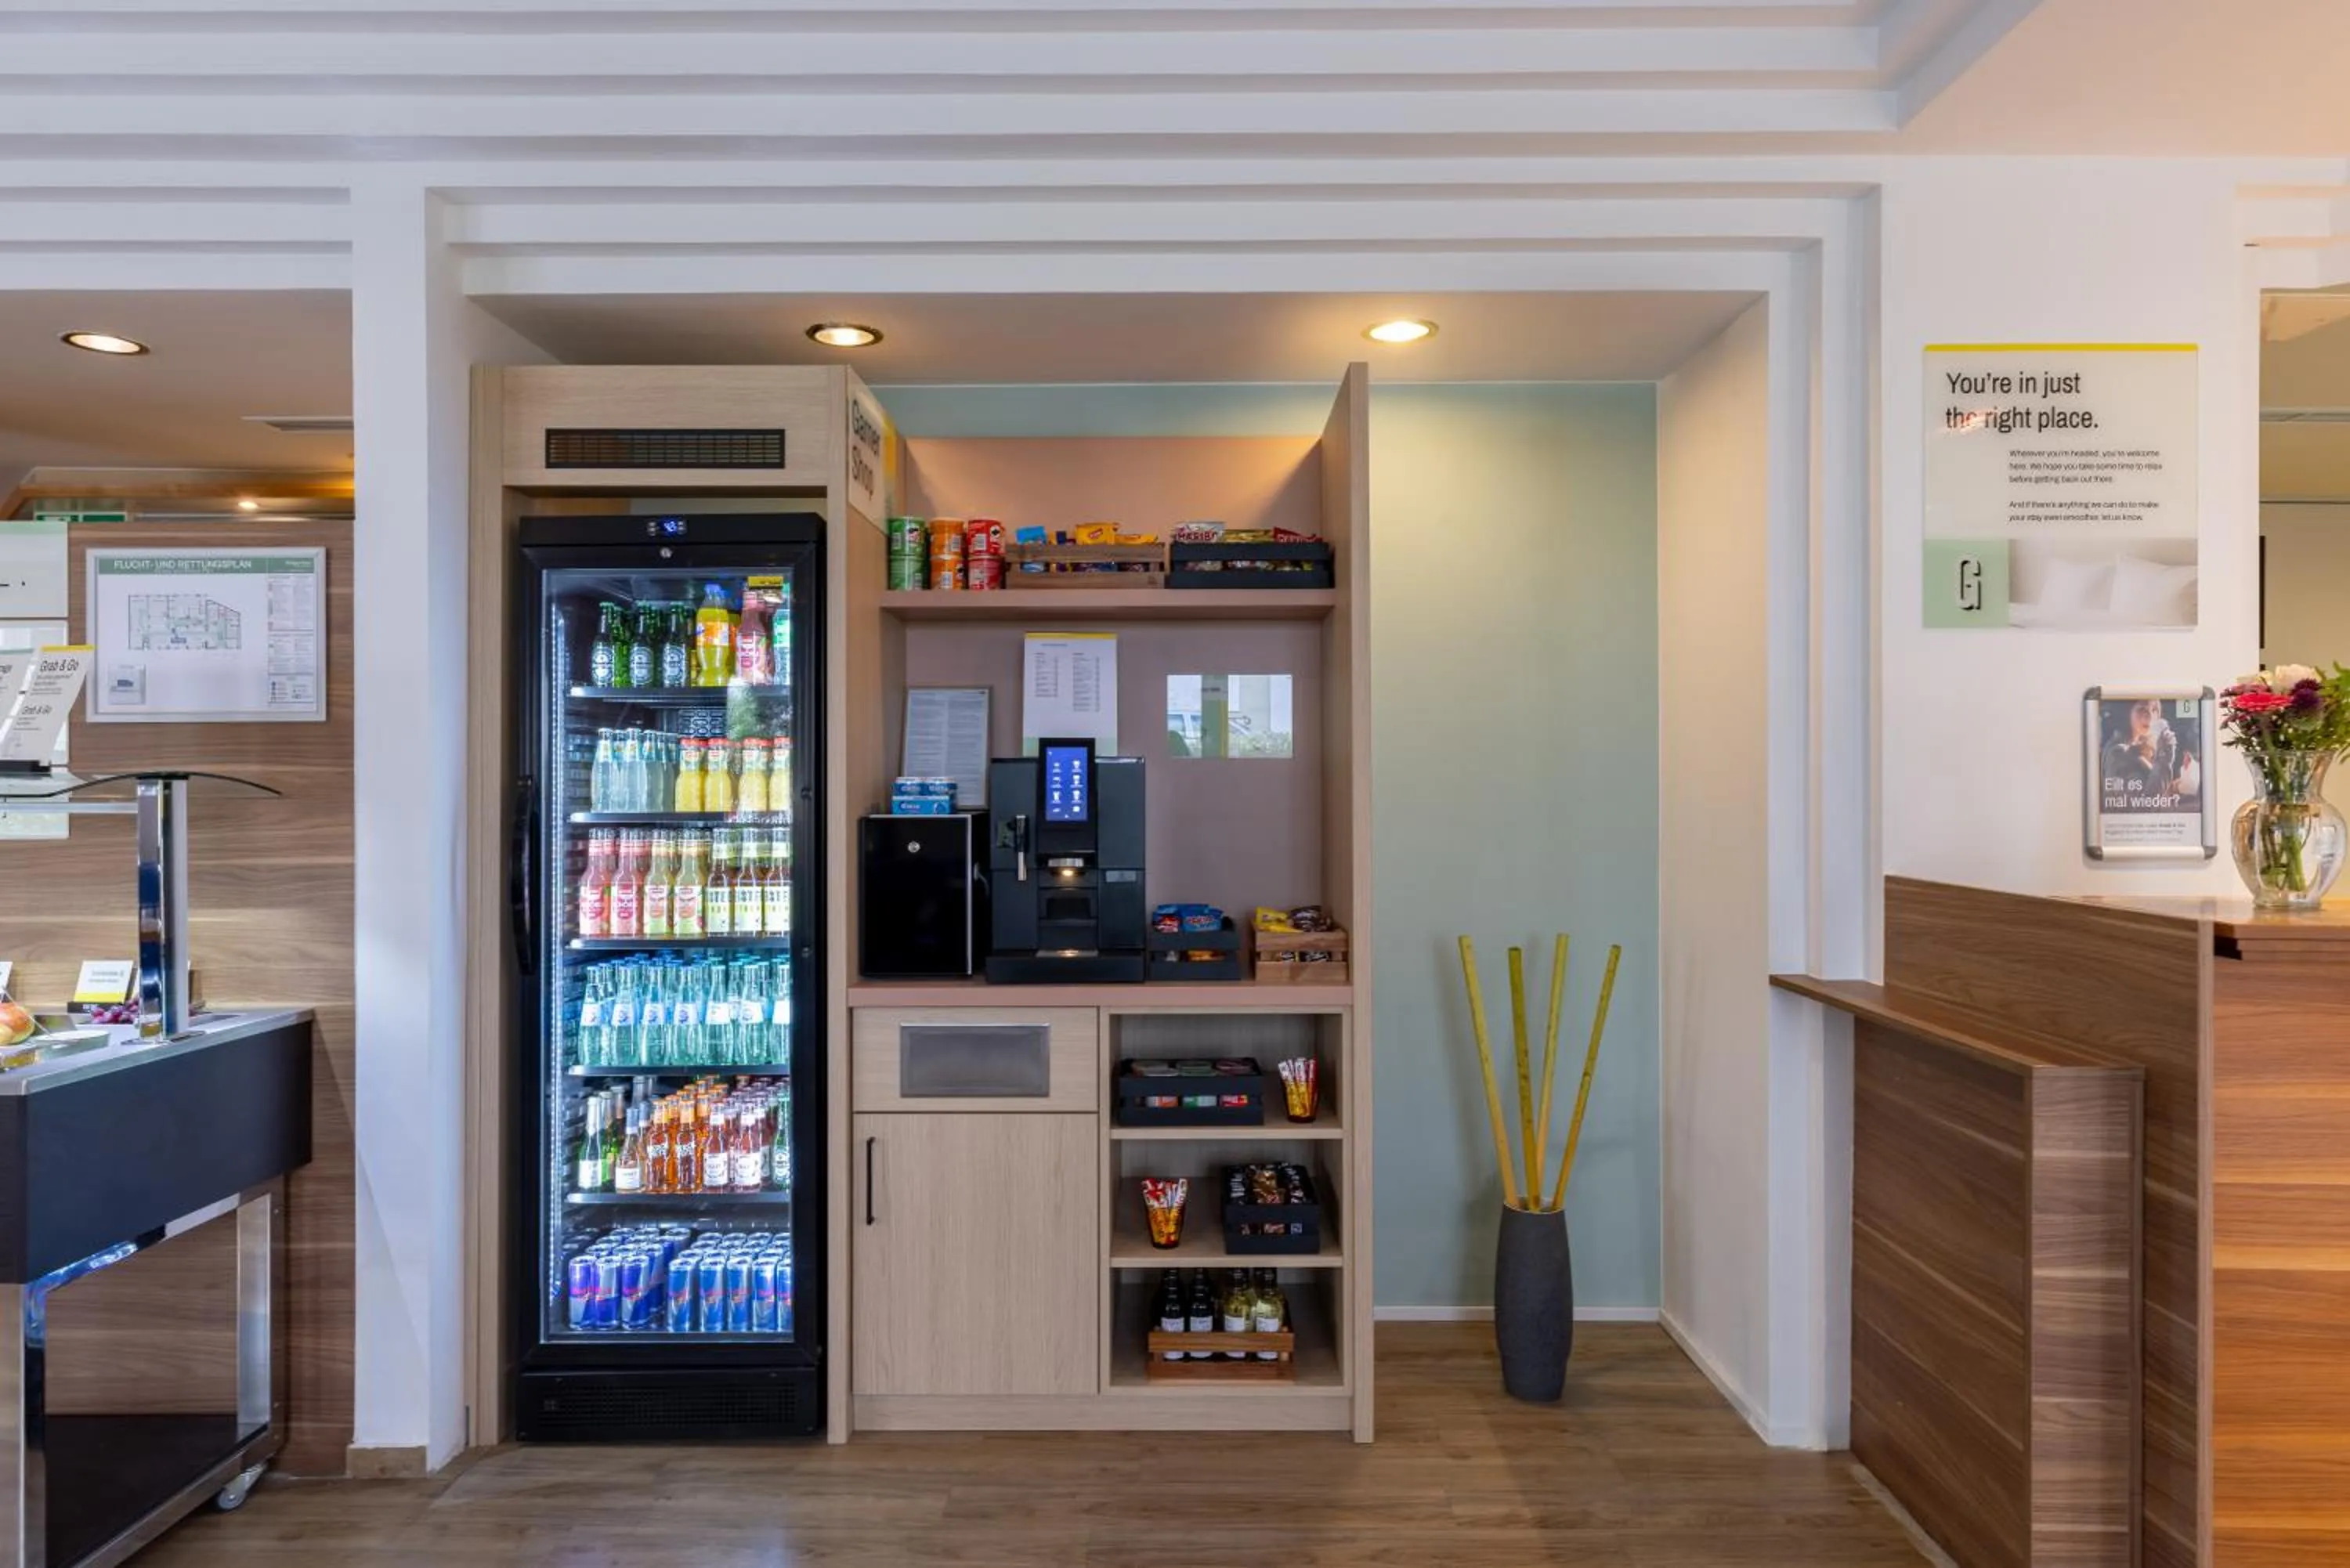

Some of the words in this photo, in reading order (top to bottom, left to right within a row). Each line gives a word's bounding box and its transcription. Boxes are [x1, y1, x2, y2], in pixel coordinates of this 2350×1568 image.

[1946, 372, 2012, 394] You're
[2019, 371, 2037, 394] in
[2041, 371, 2081, 398] just
[1946, 406, 1979, 430] the
[1984, 406, 2031, 433] right
[2037, 406, 2099, 433] place.
[2128, 779, 2143, 790] es
[2105, 793, 2127, 807] mal
[2131, 793, 2181, 807] wieder?
